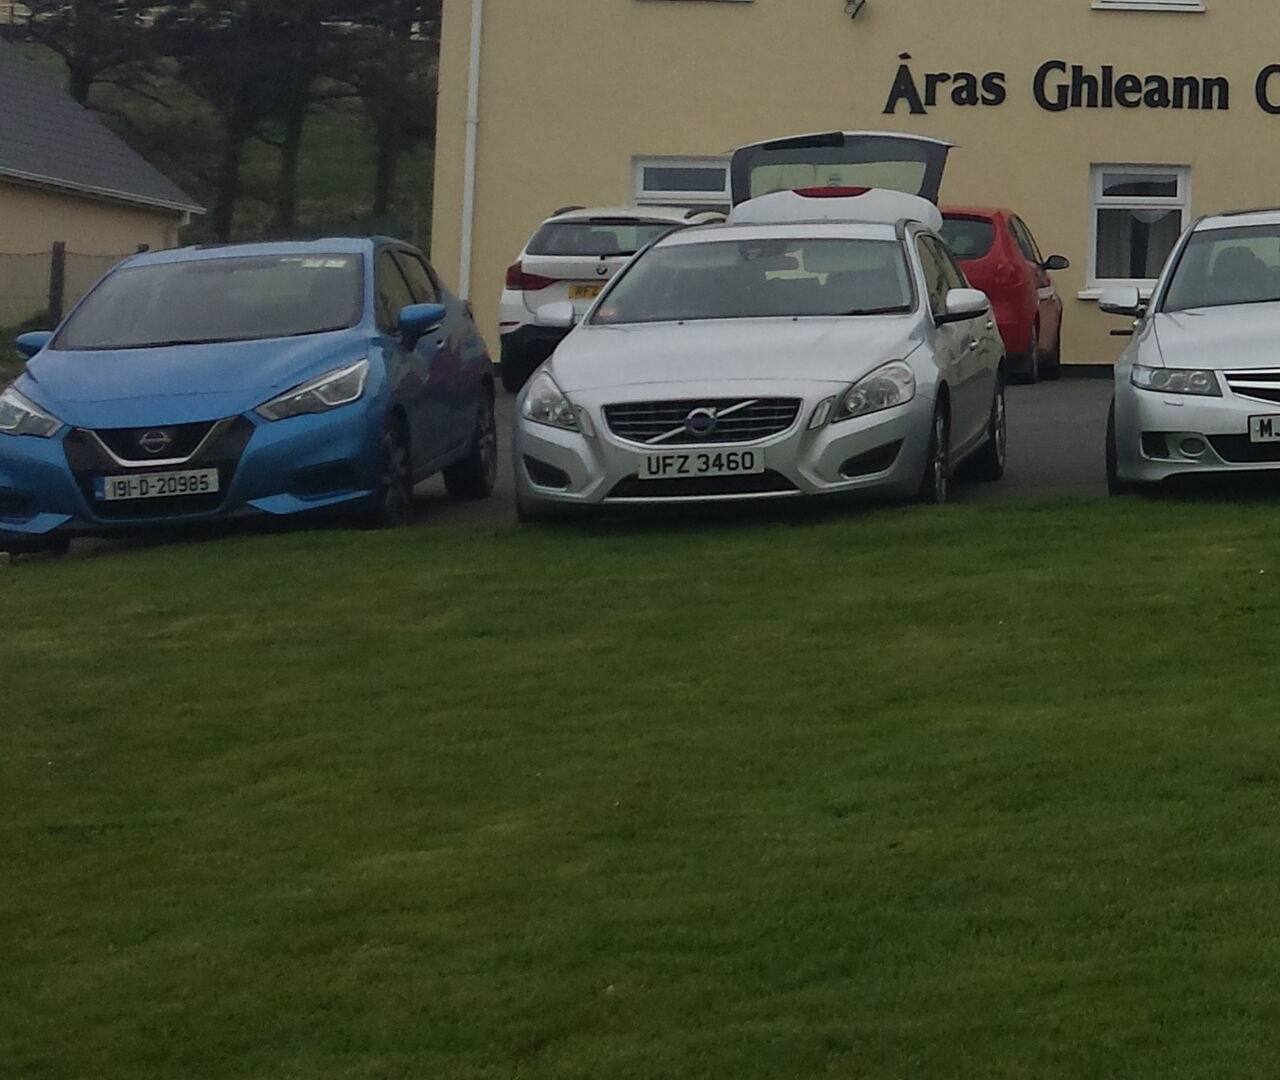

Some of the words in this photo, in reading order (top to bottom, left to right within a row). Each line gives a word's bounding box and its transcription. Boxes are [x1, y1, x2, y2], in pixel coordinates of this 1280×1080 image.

[881, 51, 1007, 115] Áras
[1032, 59, 1229, 112] Ghleann
[647, 455, 690, 475] UFZ
[697, 451, 754, 472] 3460
[112, 474, 209, 497] 191-D-20985
